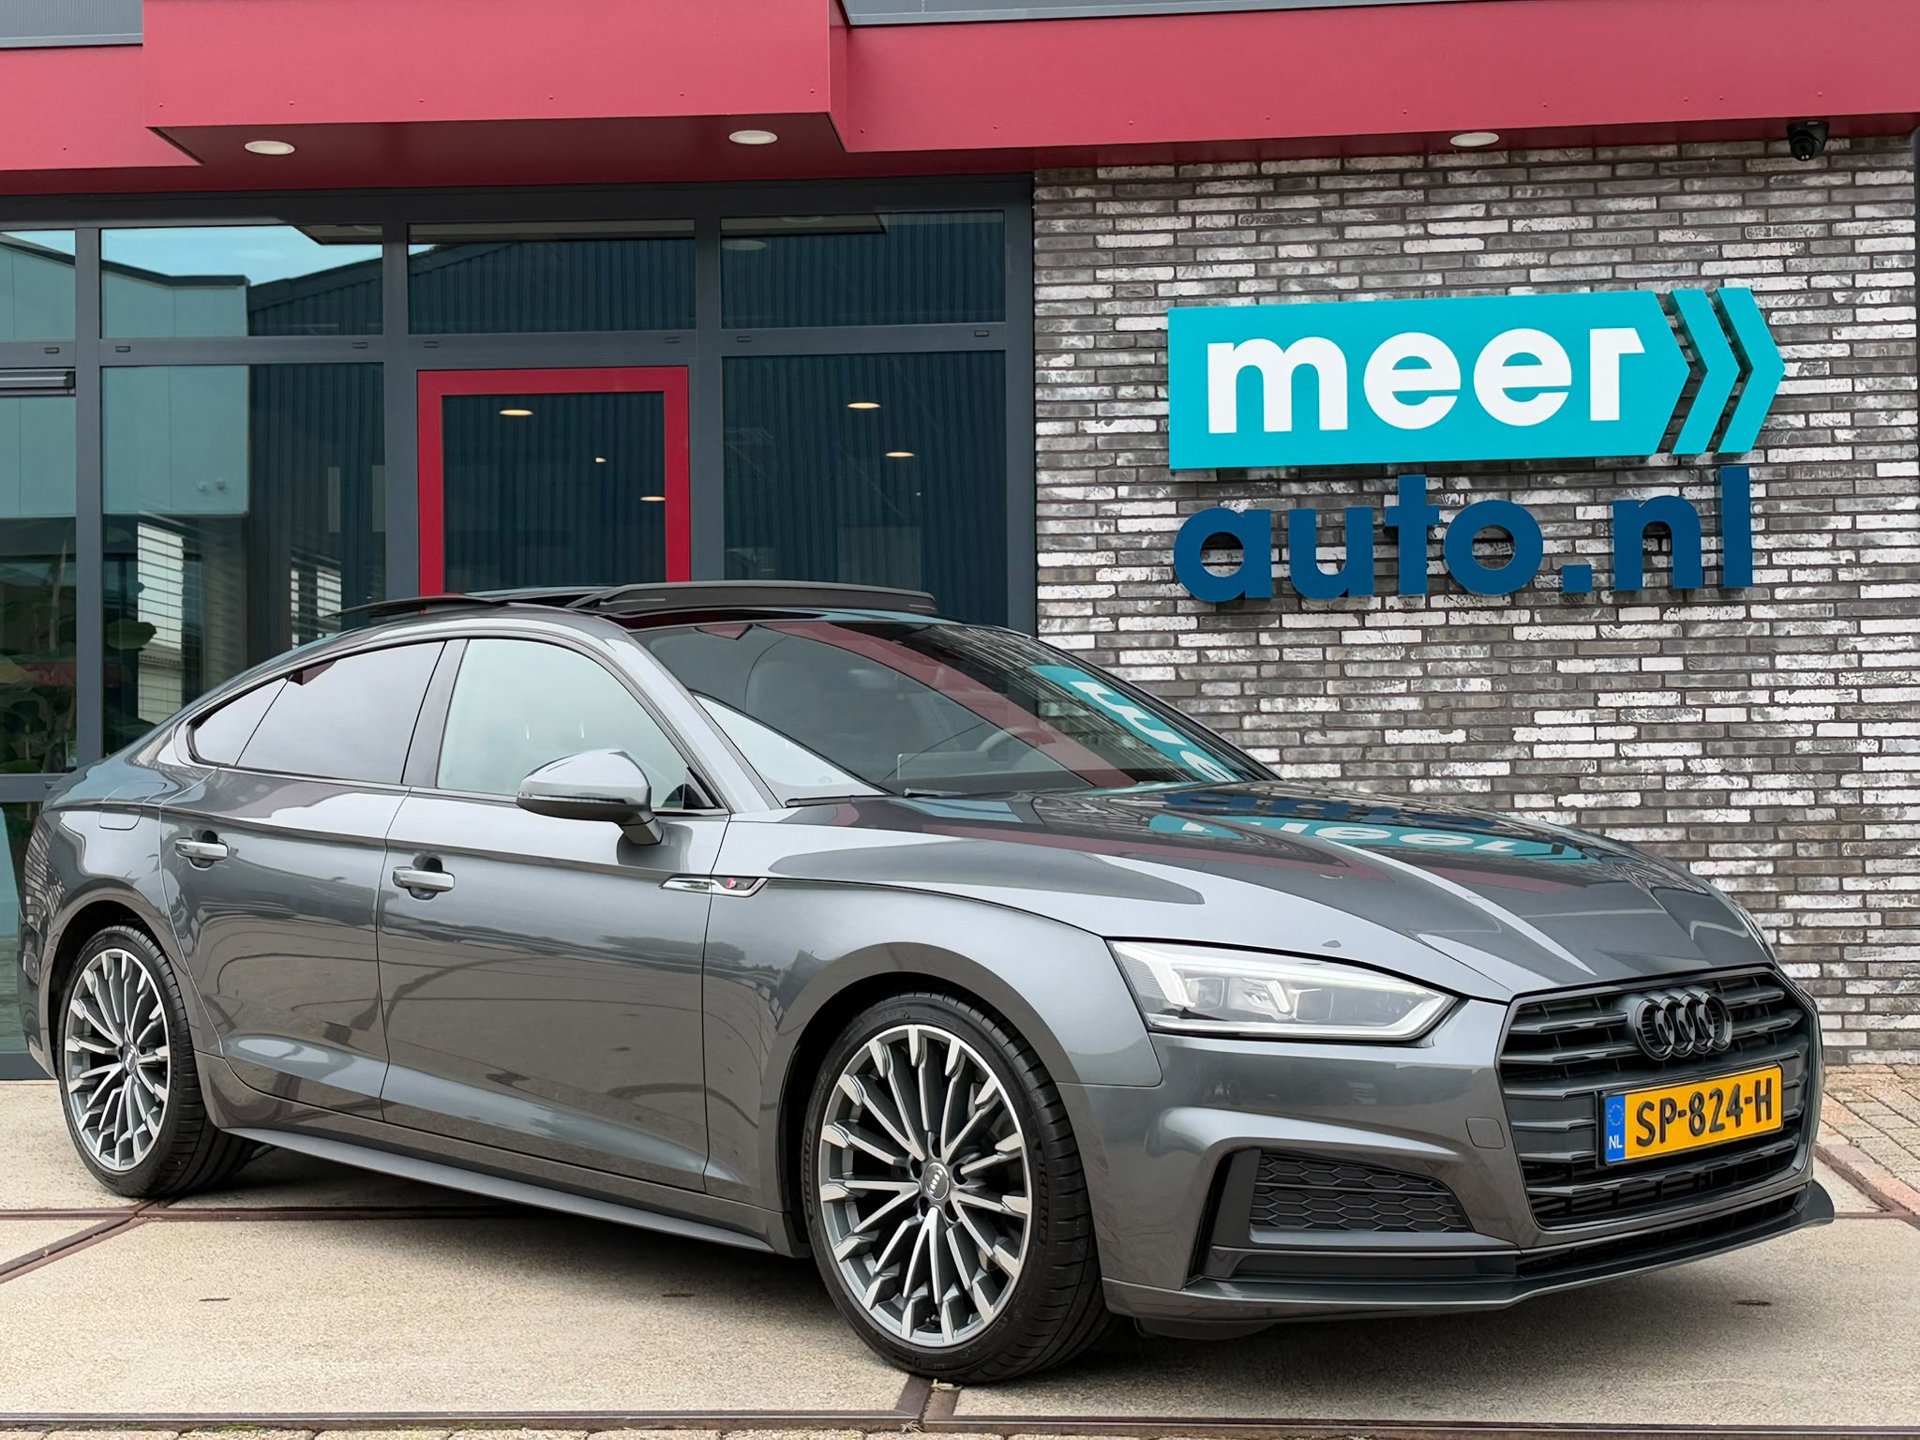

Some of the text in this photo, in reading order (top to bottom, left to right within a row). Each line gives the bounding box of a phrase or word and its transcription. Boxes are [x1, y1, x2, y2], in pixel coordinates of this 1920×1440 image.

[1207, 327, 1645, 434] meer
[1173, 465, 1753, 602] auto.nl
[1608, 1135, 1624, 1149] NL
[1636, 1077, 1772, 1147] SP-824-H
